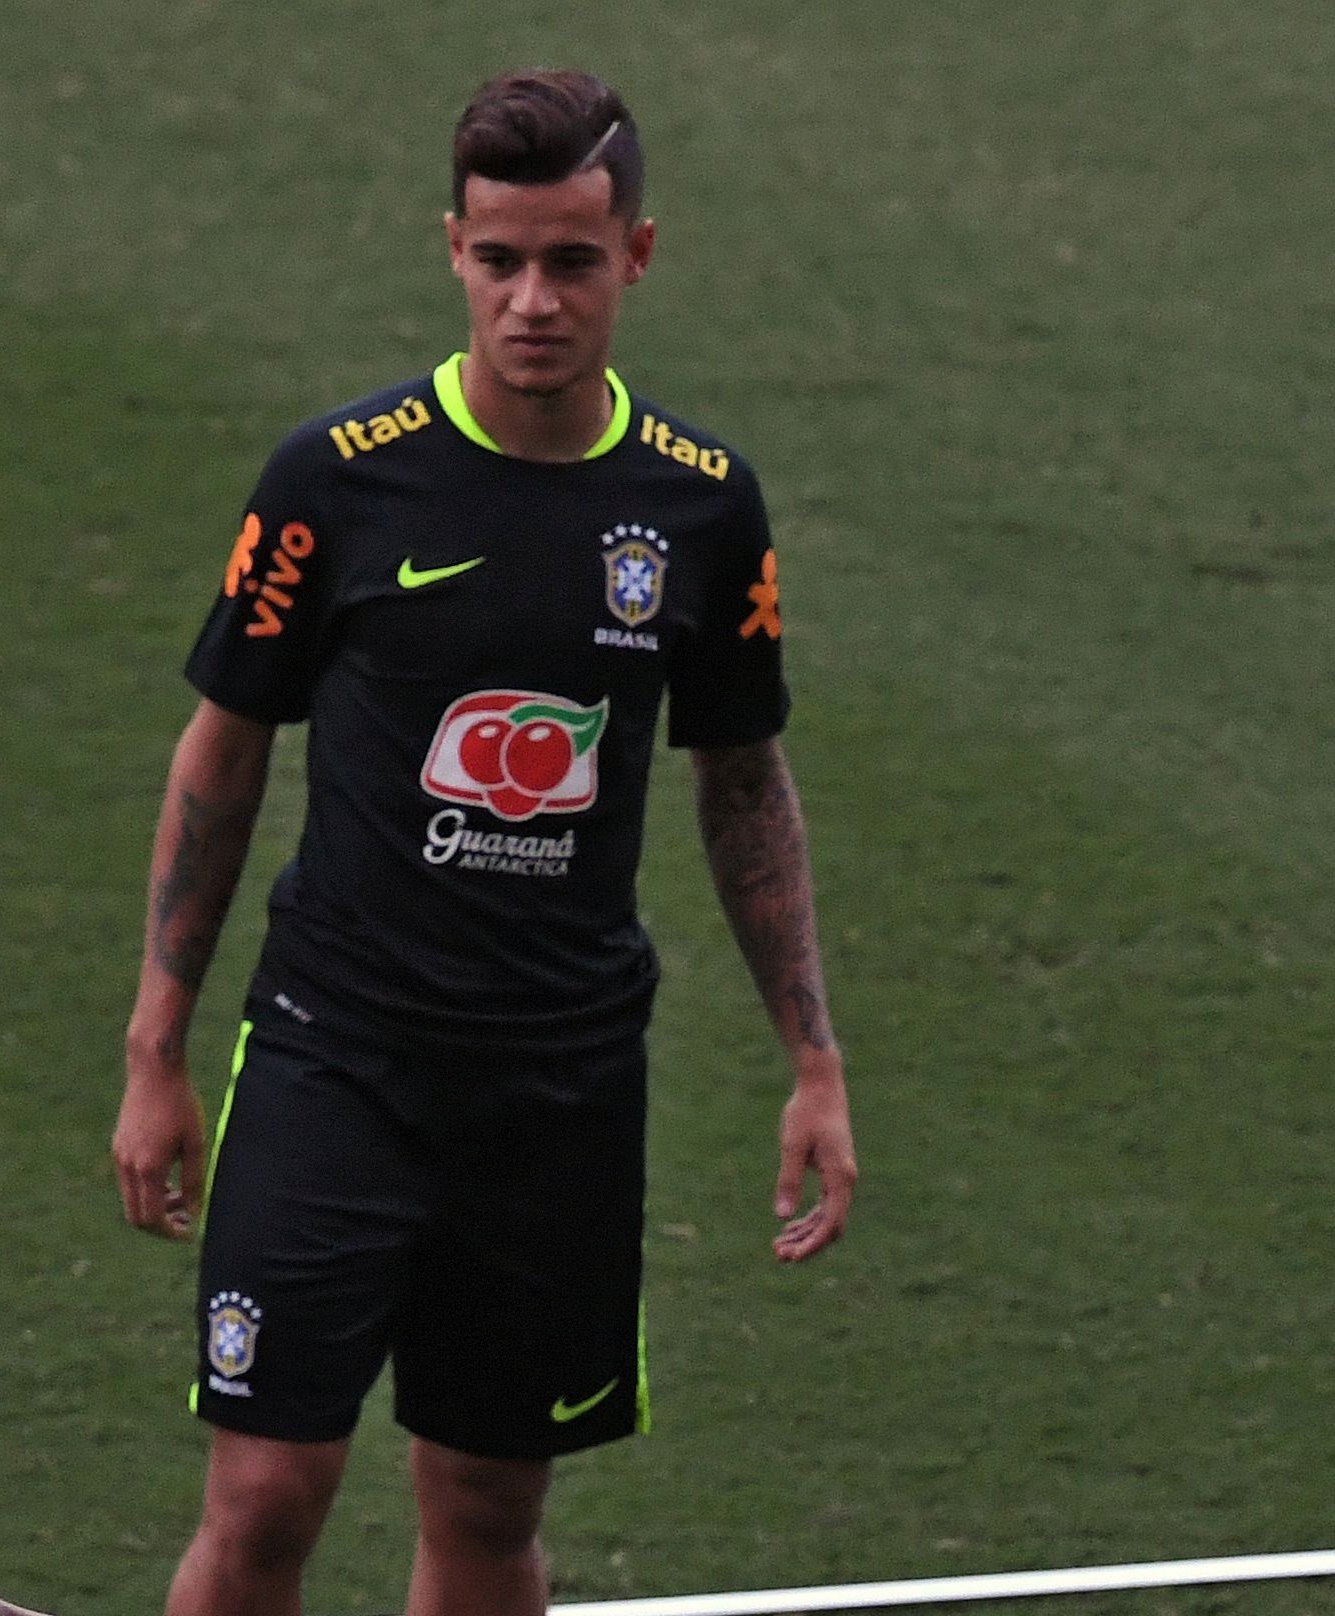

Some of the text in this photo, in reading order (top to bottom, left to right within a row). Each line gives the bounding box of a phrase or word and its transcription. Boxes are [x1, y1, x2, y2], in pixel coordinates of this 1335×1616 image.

[328, 396, 431, 460] Itaú
[640, 413, 729, 481] Itaú
[245, 521, 315, 637] vivo
